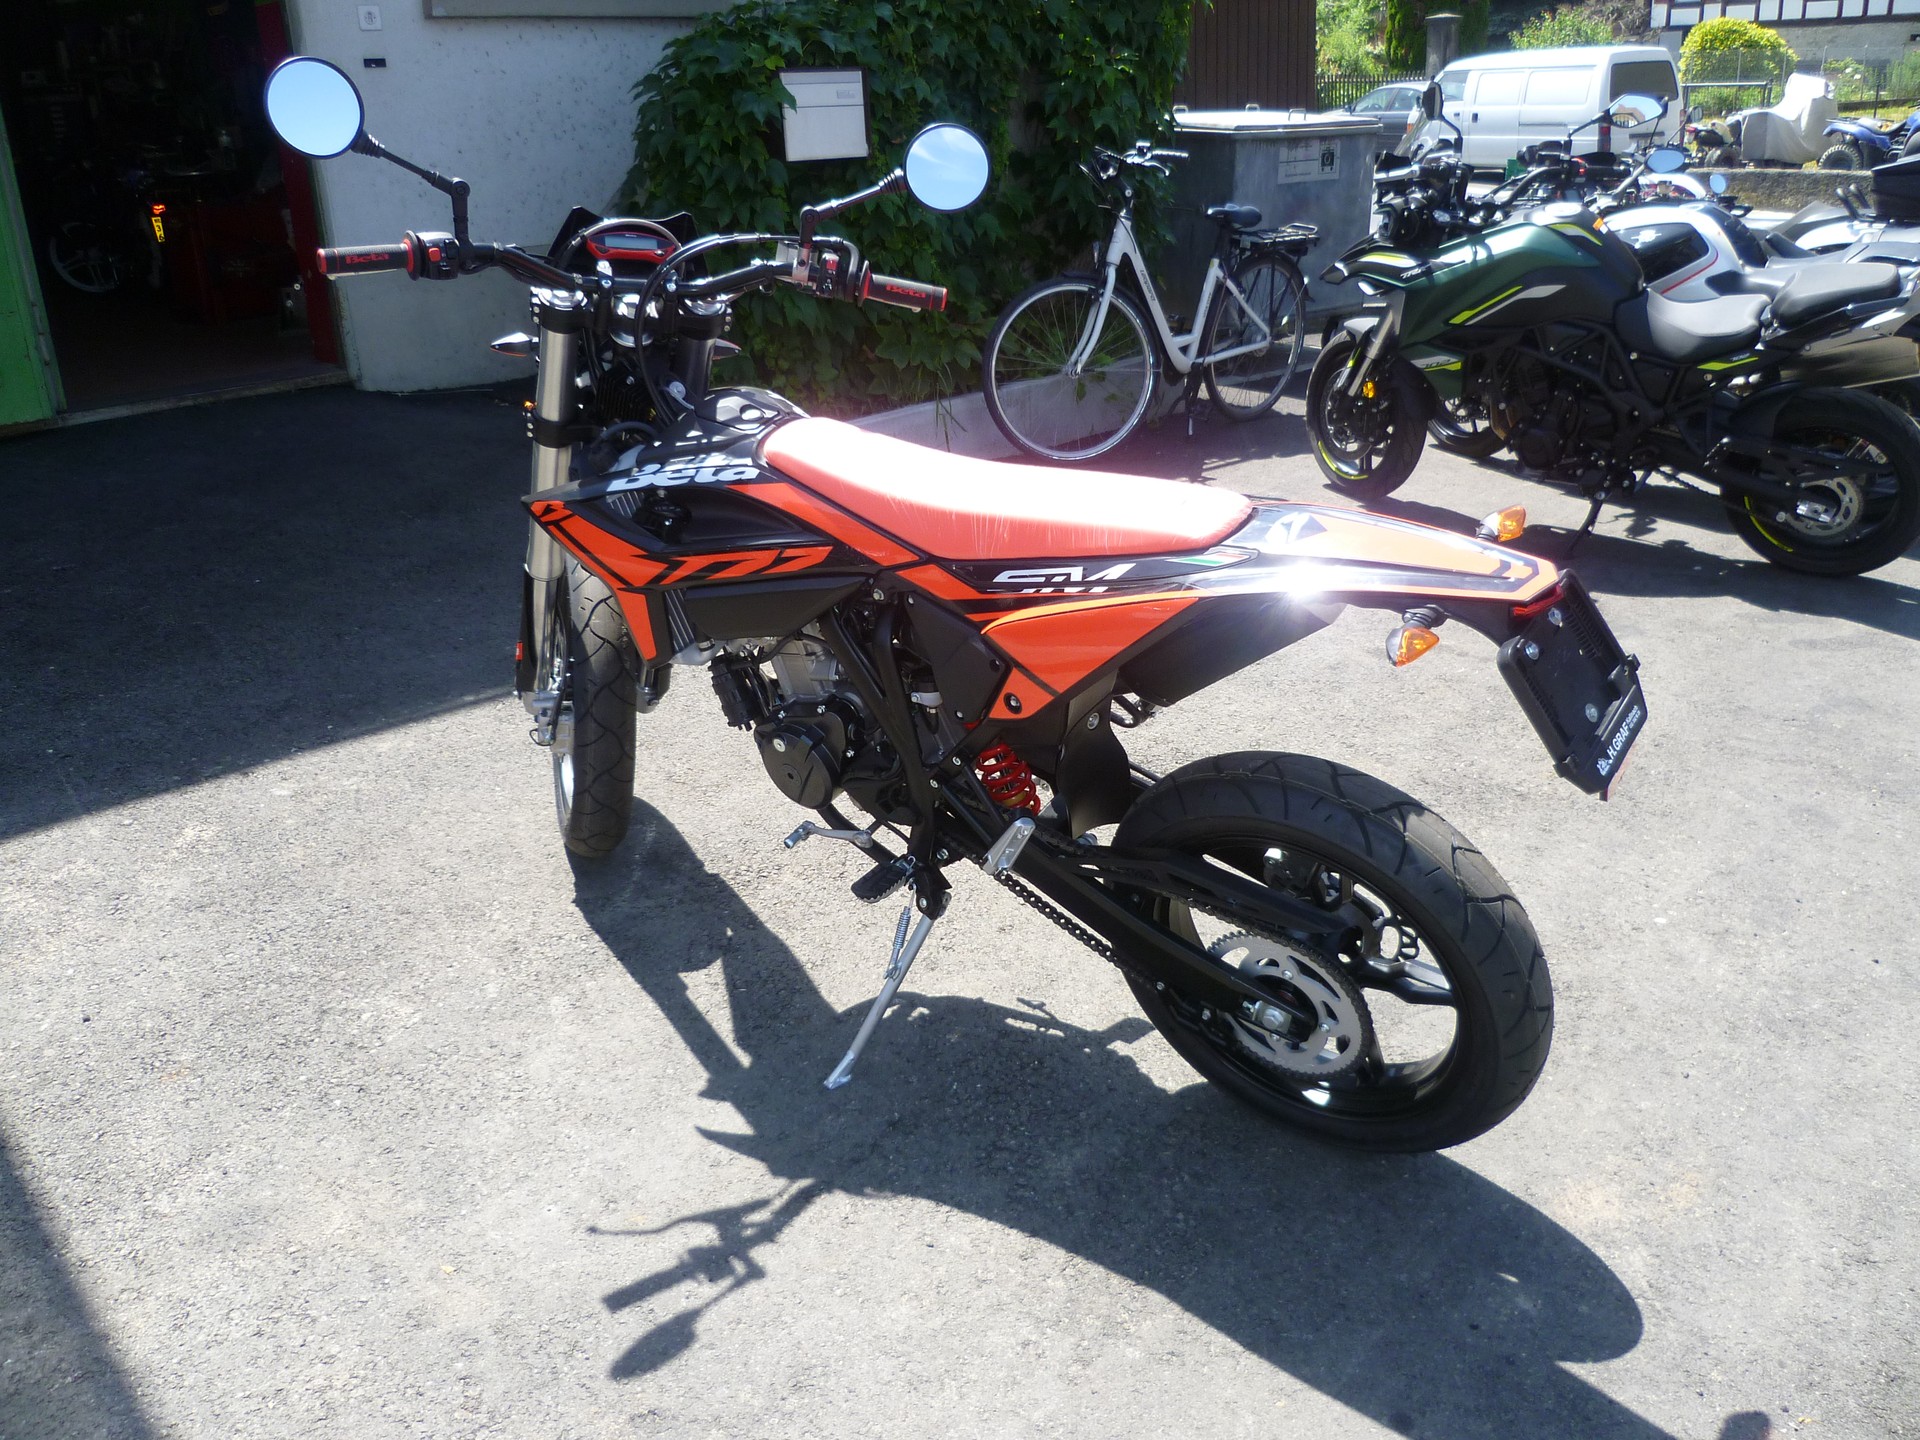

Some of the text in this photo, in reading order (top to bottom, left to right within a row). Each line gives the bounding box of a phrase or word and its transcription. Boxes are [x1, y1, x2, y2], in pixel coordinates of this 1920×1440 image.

[345, 253, 389, 265] Beta
[886, 284, 927, 298] Beta
[606, 455, 760, 492] Beta
